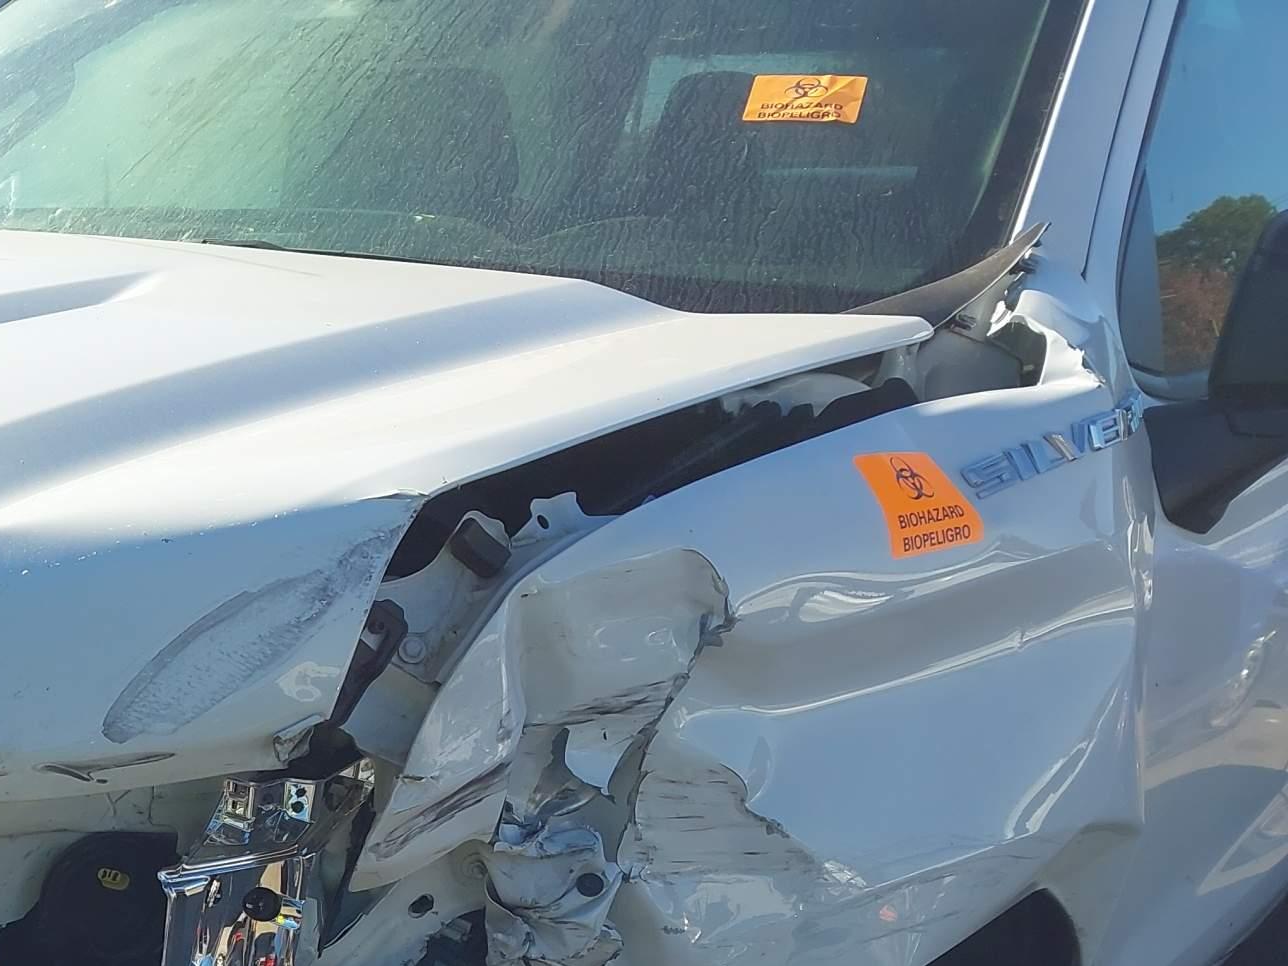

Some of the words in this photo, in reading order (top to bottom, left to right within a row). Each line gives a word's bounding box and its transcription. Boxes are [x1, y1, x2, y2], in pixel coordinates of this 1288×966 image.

[760, 102, 843, 110] BIOHAZARD
[757, 111, 841, 119] BIOPELIGRO
[898, 504, 965, 529] BIOHAZARD
[903, 524, 971, 552] BIOPELIGRO
